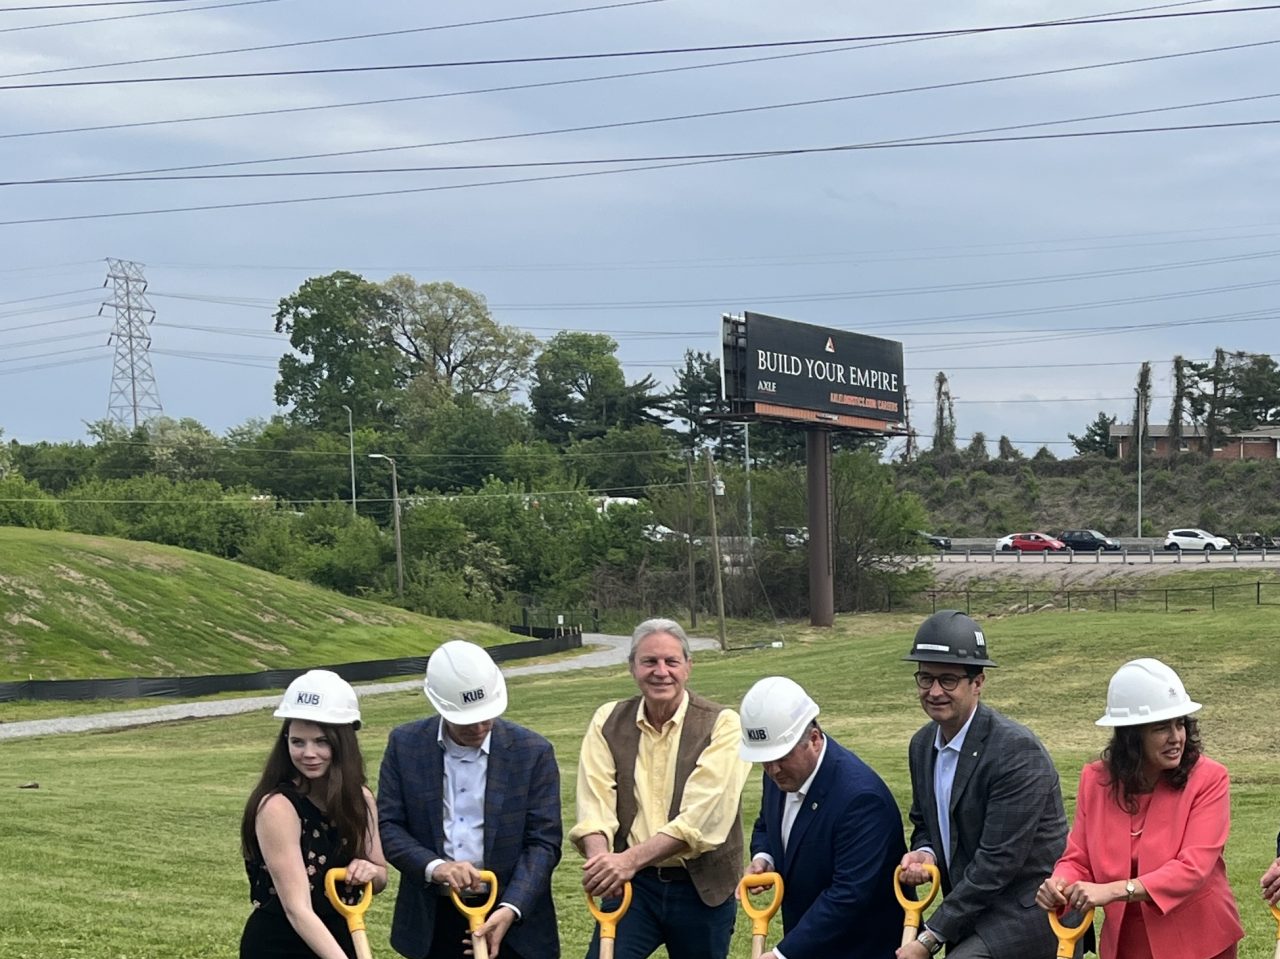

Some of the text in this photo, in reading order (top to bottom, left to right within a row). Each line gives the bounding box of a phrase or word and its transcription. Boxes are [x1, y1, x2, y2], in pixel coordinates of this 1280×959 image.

[757, 349, 899, 393] BUILD YOUR EMPIRE
[757, 380, 777, 393] AXLE
[297, 692, 320, 705] KUB
[462, 689, 485, 703] KUB
[747, 729, 767, 740] KUB
